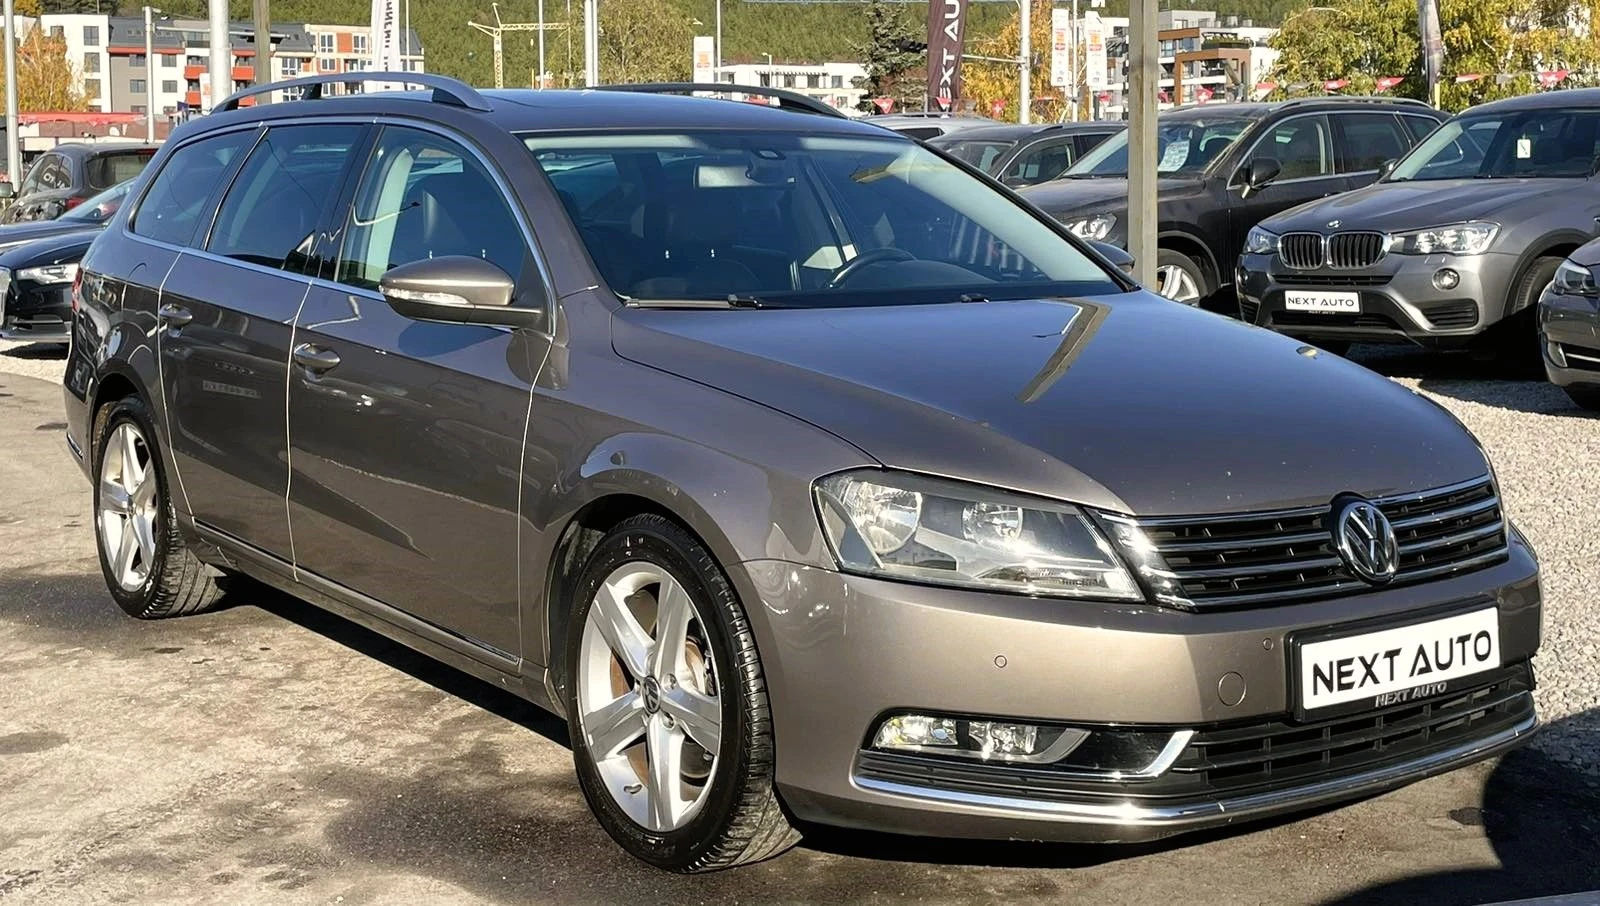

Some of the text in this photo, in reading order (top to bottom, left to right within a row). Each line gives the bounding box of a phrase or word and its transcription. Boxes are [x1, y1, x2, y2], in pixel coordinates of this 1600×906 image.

[1288, 297, 1355, 307] NEXT AUTO
[1312, 630, 1491, 696] NEXT AUTO
[1375, 681, 1447, 708] NEXT AUTO
